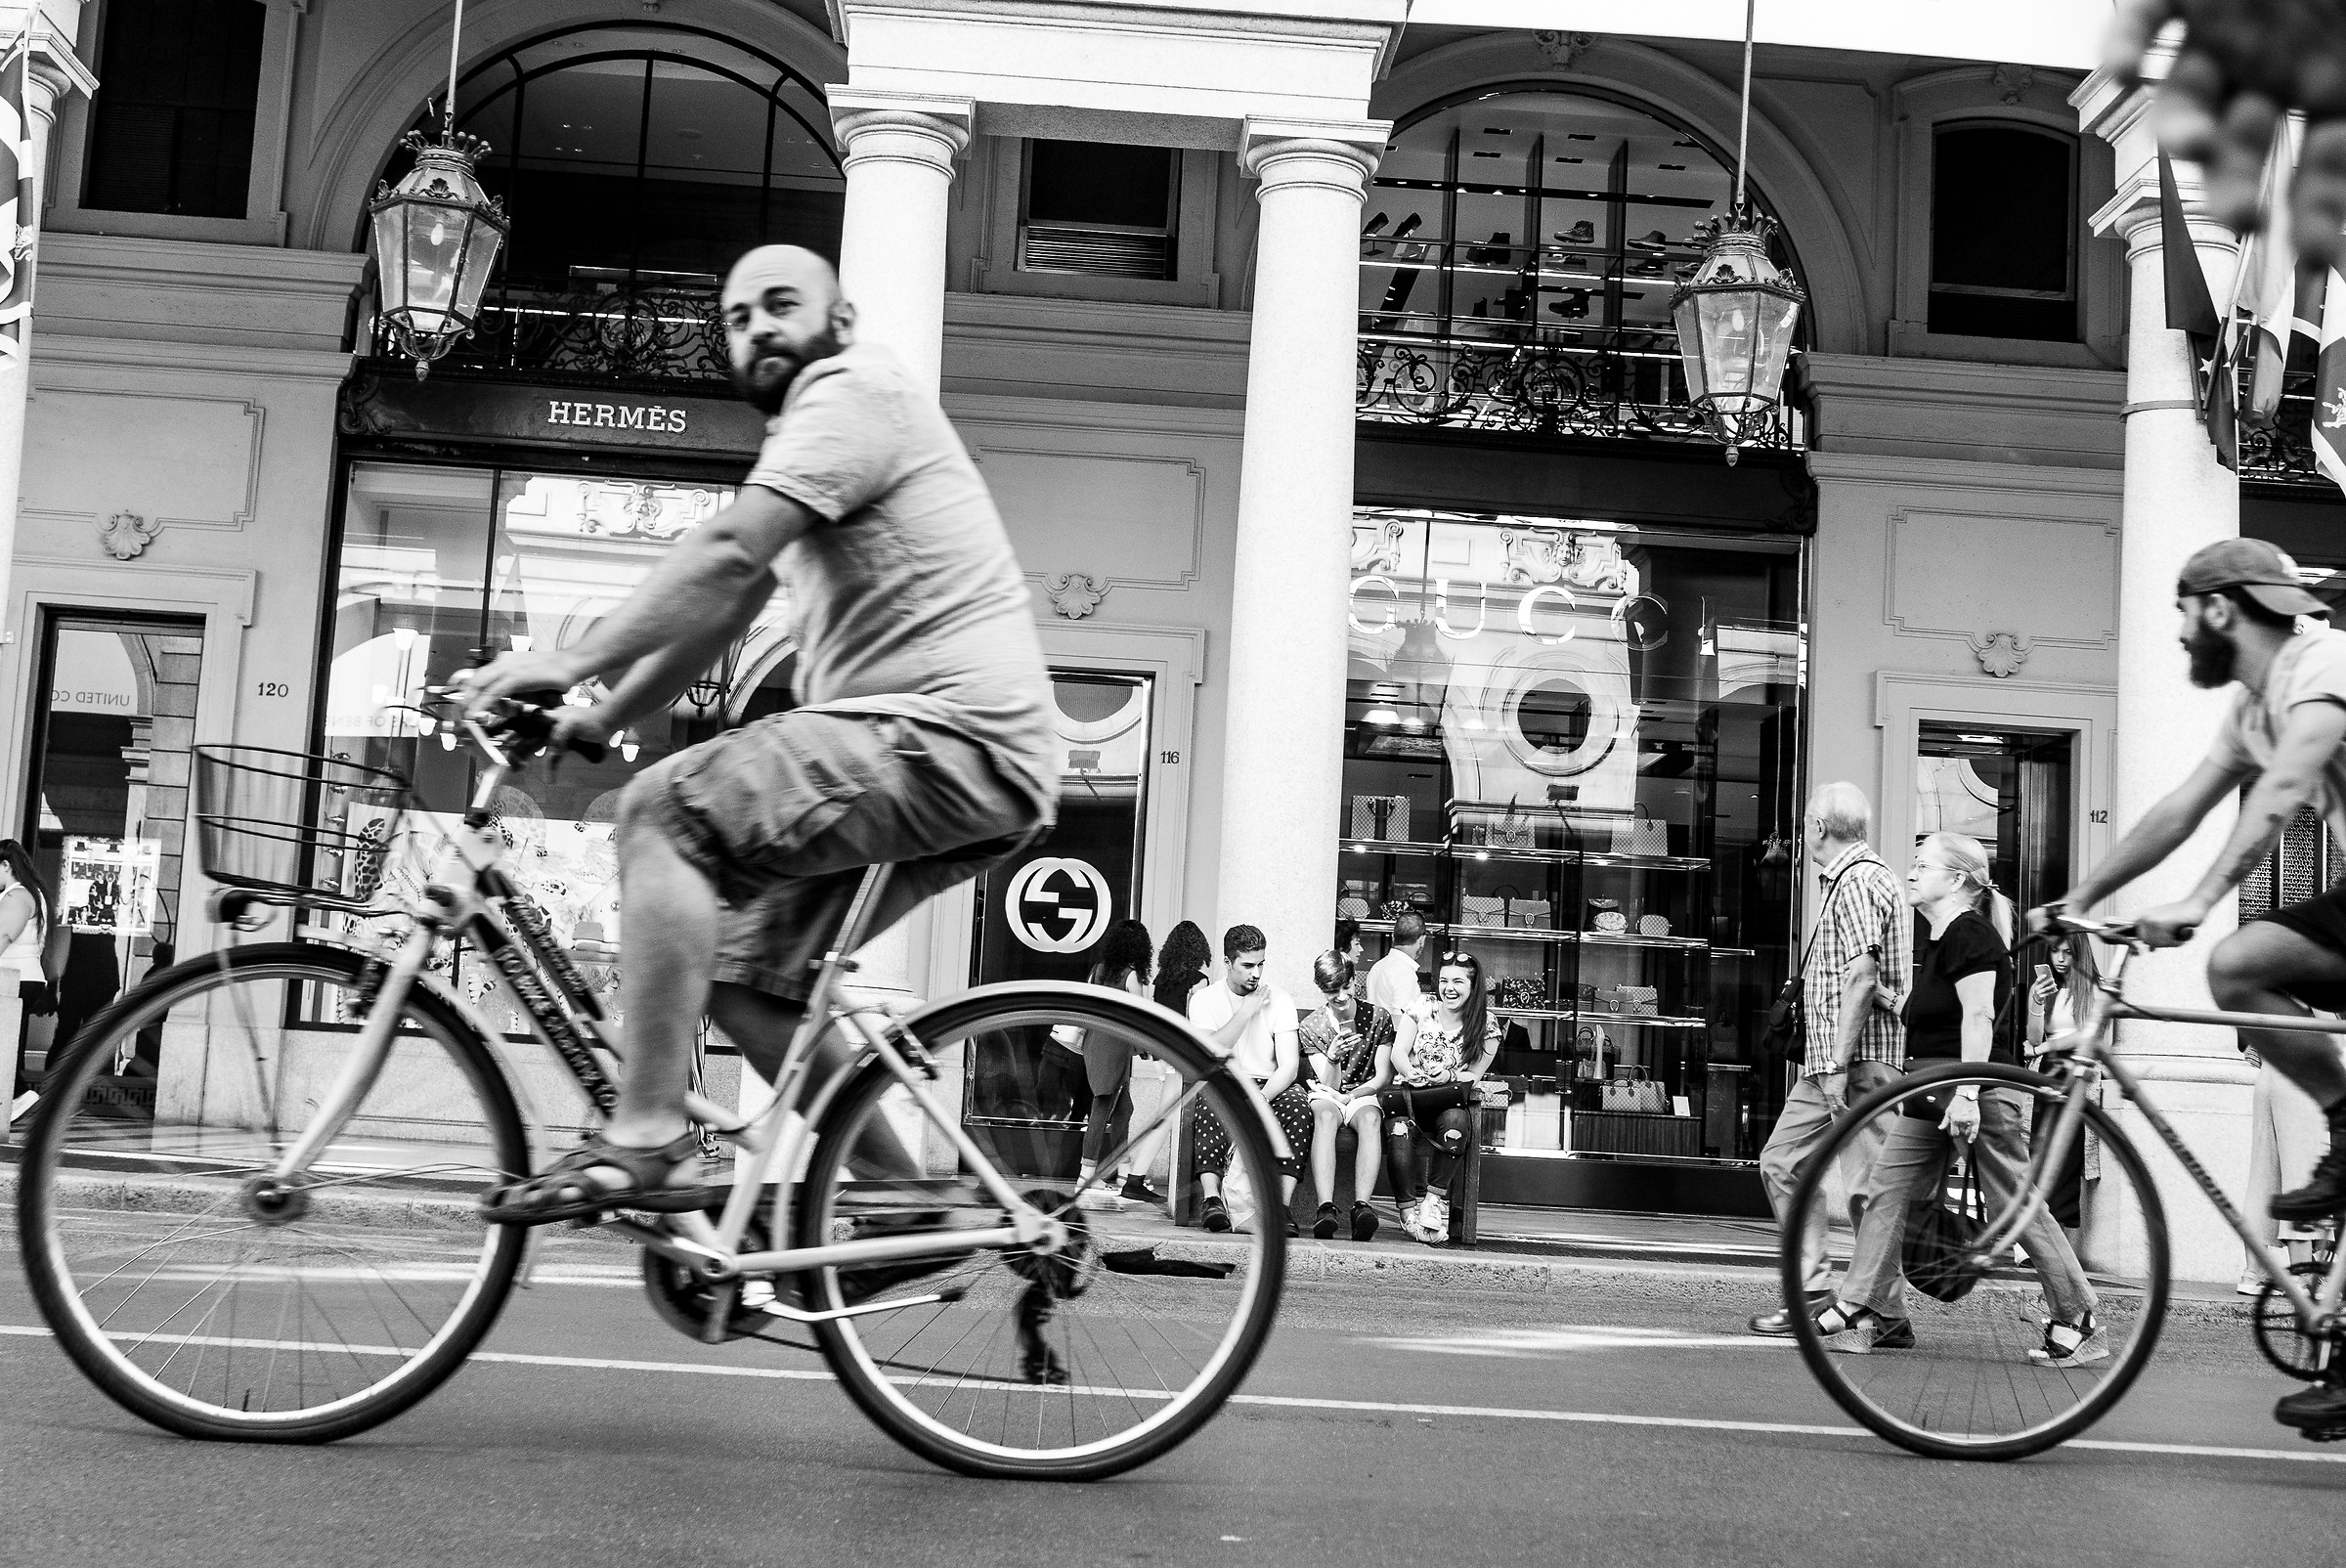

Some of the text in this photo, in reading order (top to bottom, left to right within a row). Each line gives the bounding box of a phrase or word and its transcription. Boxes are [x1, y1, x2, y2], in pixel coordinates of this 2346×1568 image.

[258, 682, 289, 698] 120
[1160, 750, 1180, 764] 116
[2090, 809, 2108, 824] 112
